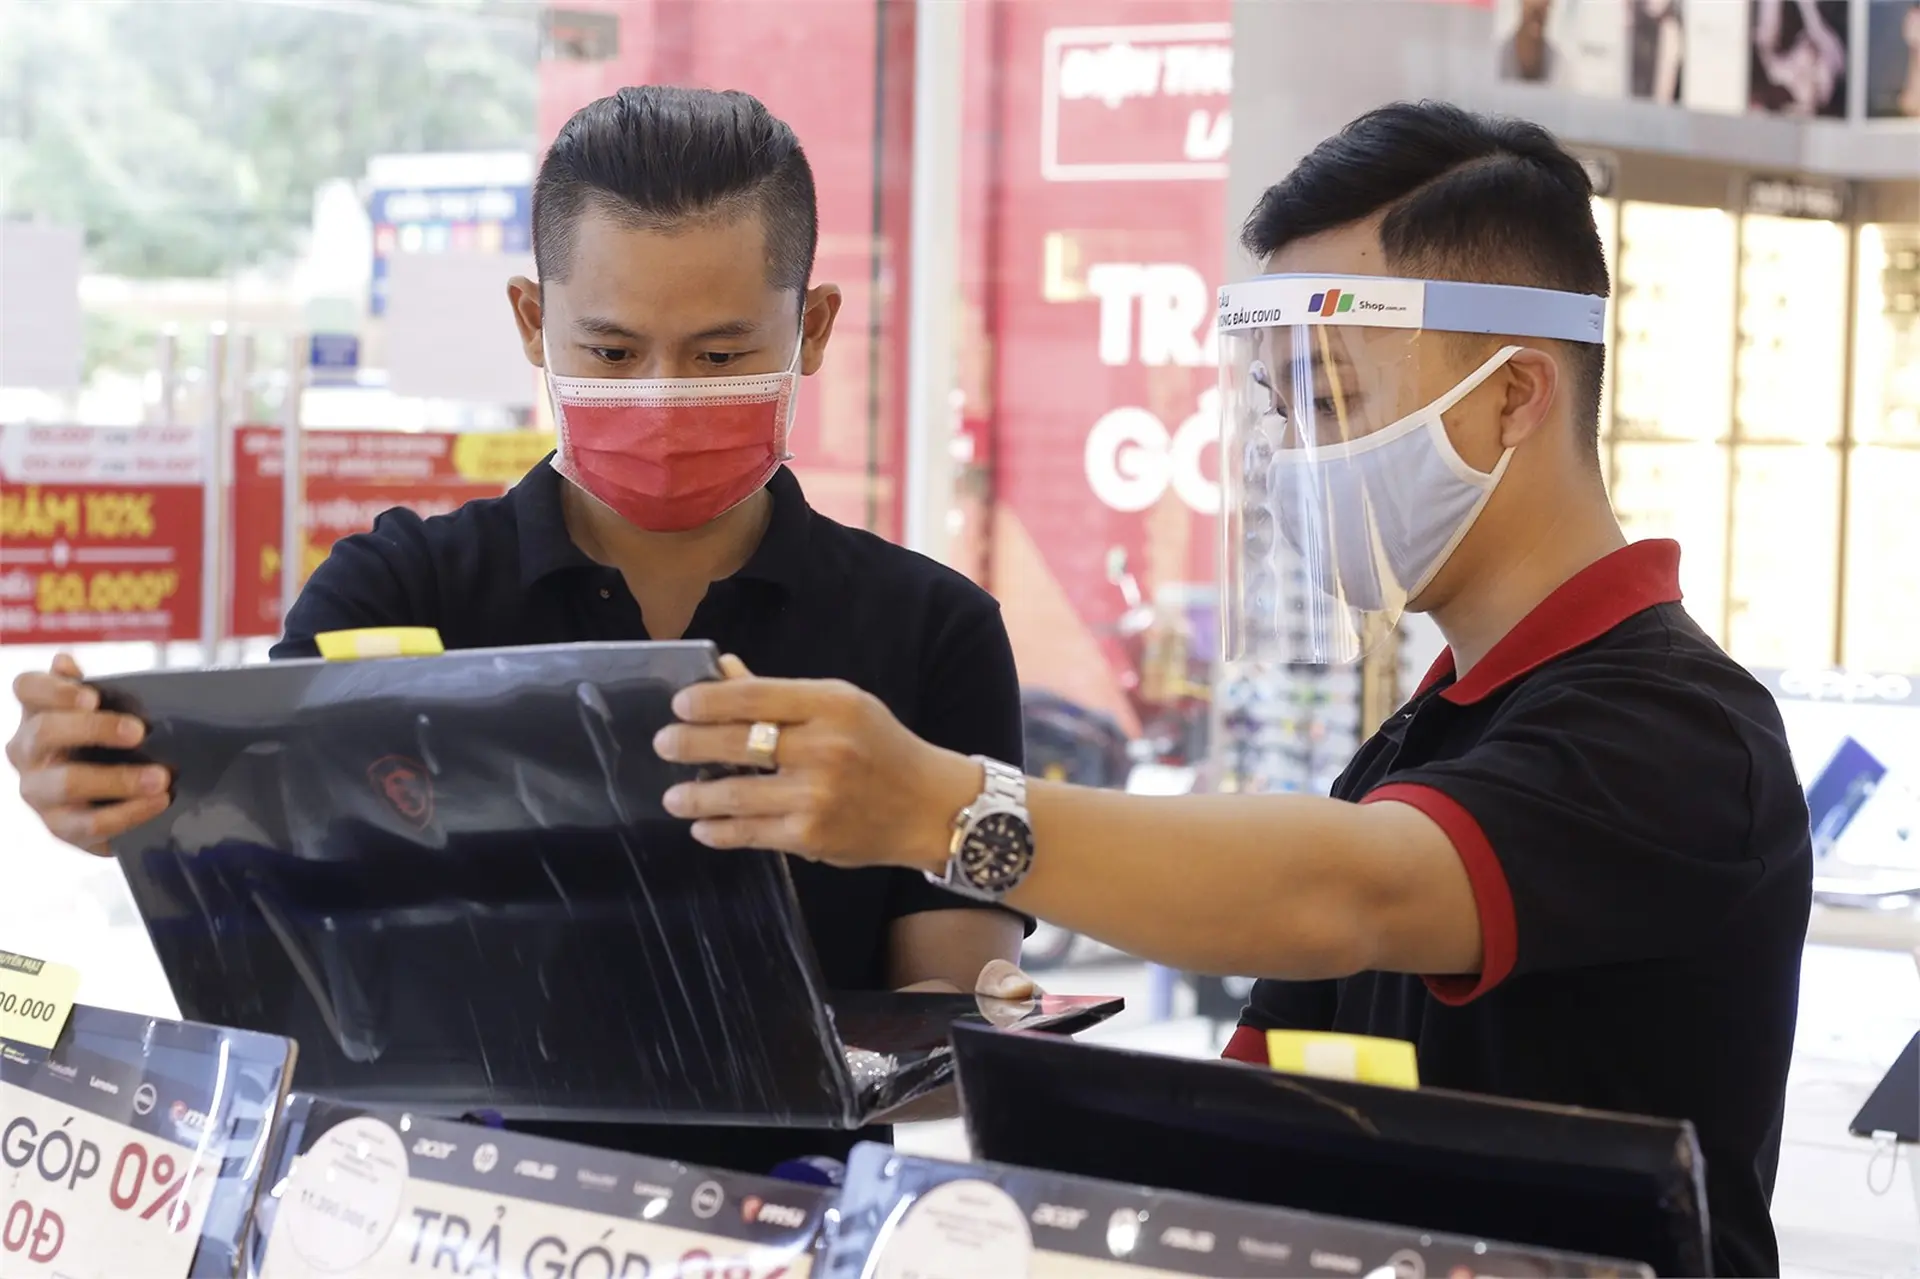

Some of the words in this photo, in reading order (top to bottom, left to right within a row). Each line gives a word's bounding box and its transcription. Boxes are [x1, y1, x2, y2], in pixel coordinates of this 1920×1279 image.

[1251, 308, 1282, 323] COVID
[2, 1116, 101, 1190] GÓP
[109, 1142, 204, 1233] 0%
[410, 1205, 507, 1279] TRẢ
